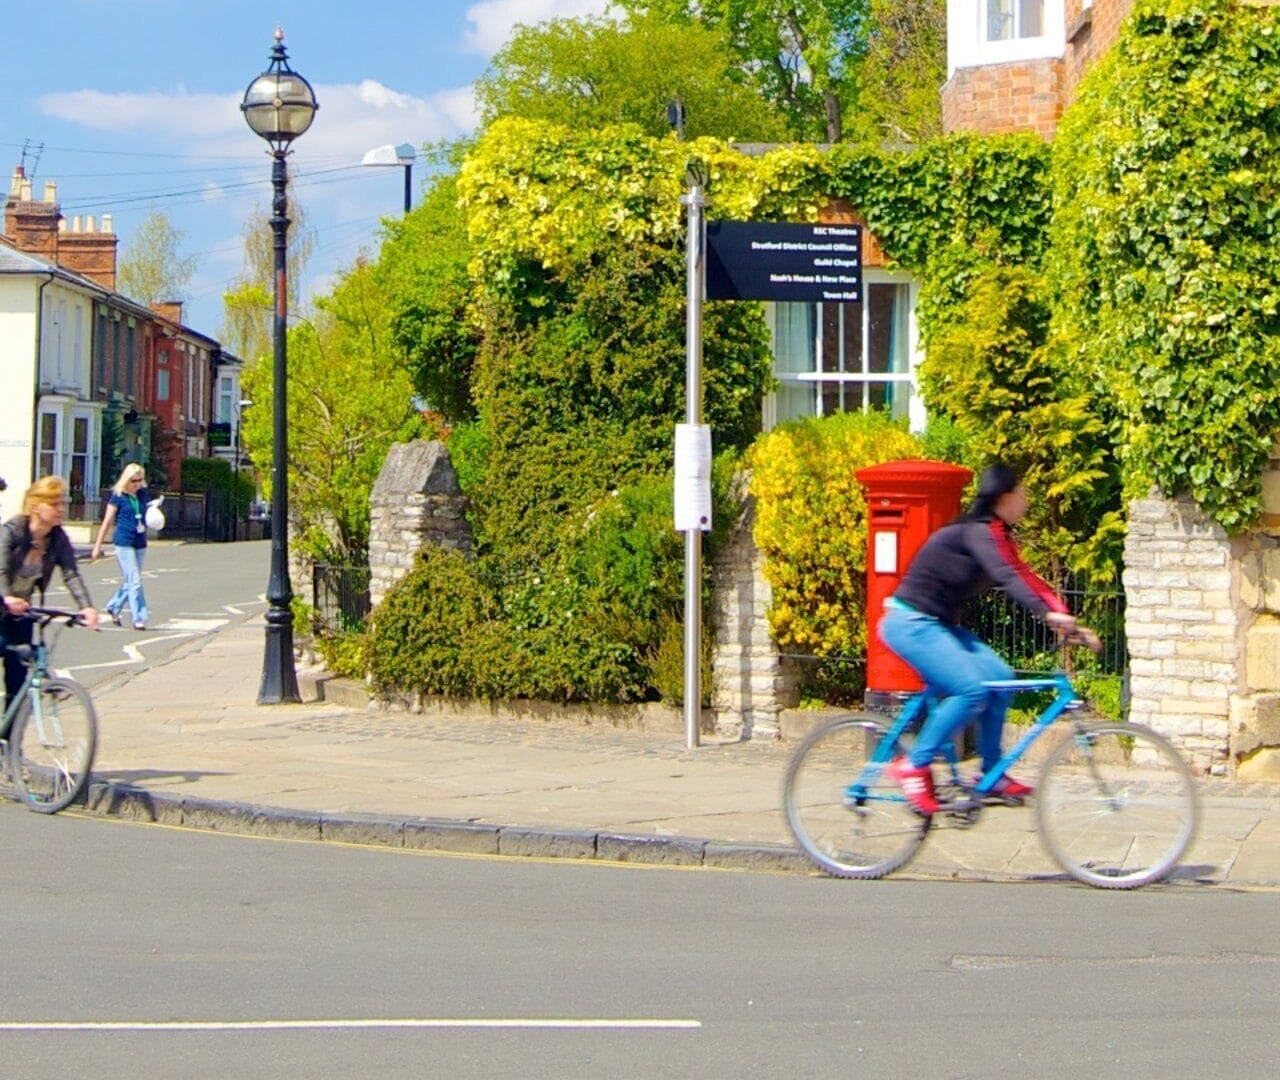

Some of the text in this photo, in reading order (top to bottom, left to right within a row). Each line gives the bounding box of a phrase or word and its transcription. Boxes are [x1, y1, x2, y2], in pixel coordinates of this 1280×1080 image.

[751, 241, 782, 250] Stratford
[823, 291, 858, 299] Town Hall
